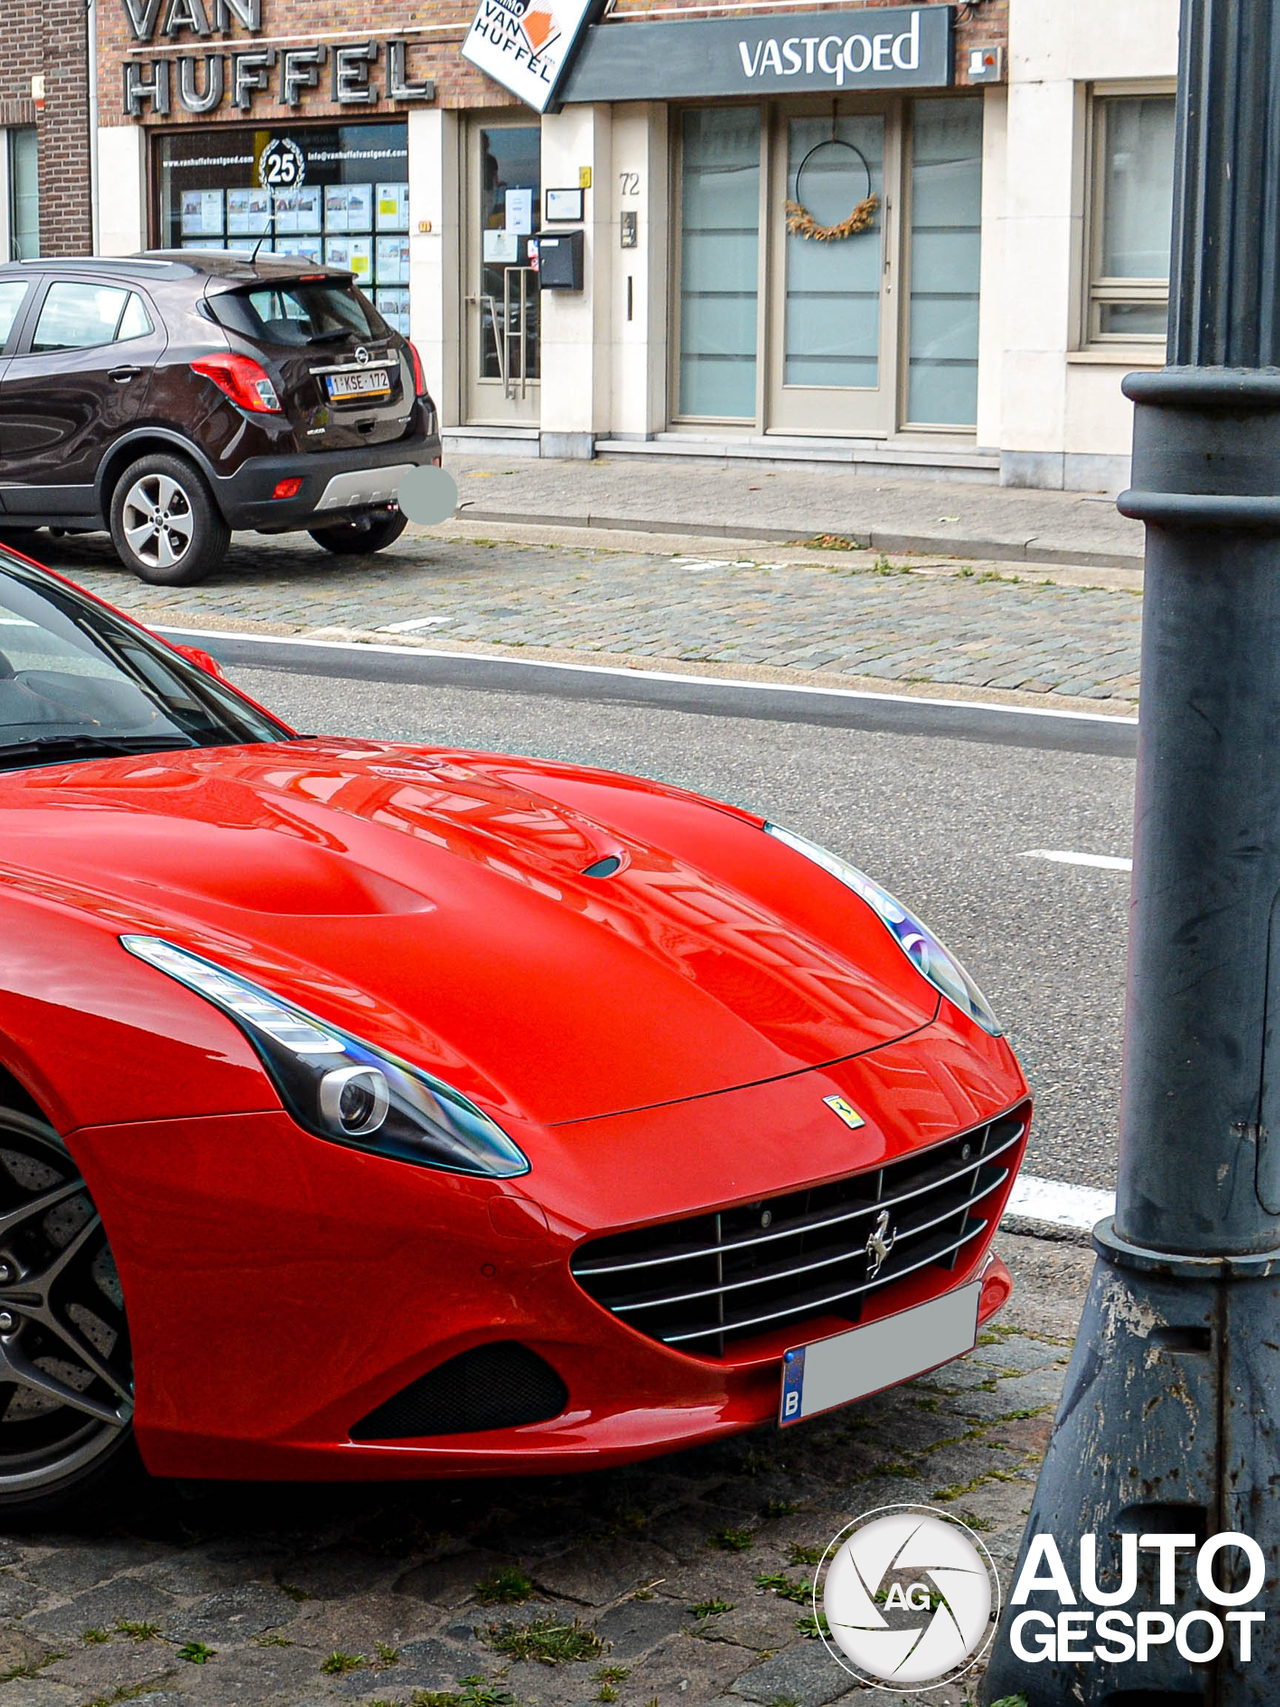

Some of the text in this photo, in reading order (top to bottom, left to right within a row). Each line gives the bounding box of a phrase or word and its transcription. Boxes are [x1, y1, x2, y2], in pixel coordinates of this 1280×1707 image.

[126, 0, 263, 41] VAN
[486, 1, 521, 37] VAN
[475, 18, 550, 84] HUFFEL
[122, 39, 435, 117] HUFFEL
[268, 153, 296, 183] 25
[619, 172, 640, 196] 72
[785, 1390, 799, 1416] B
